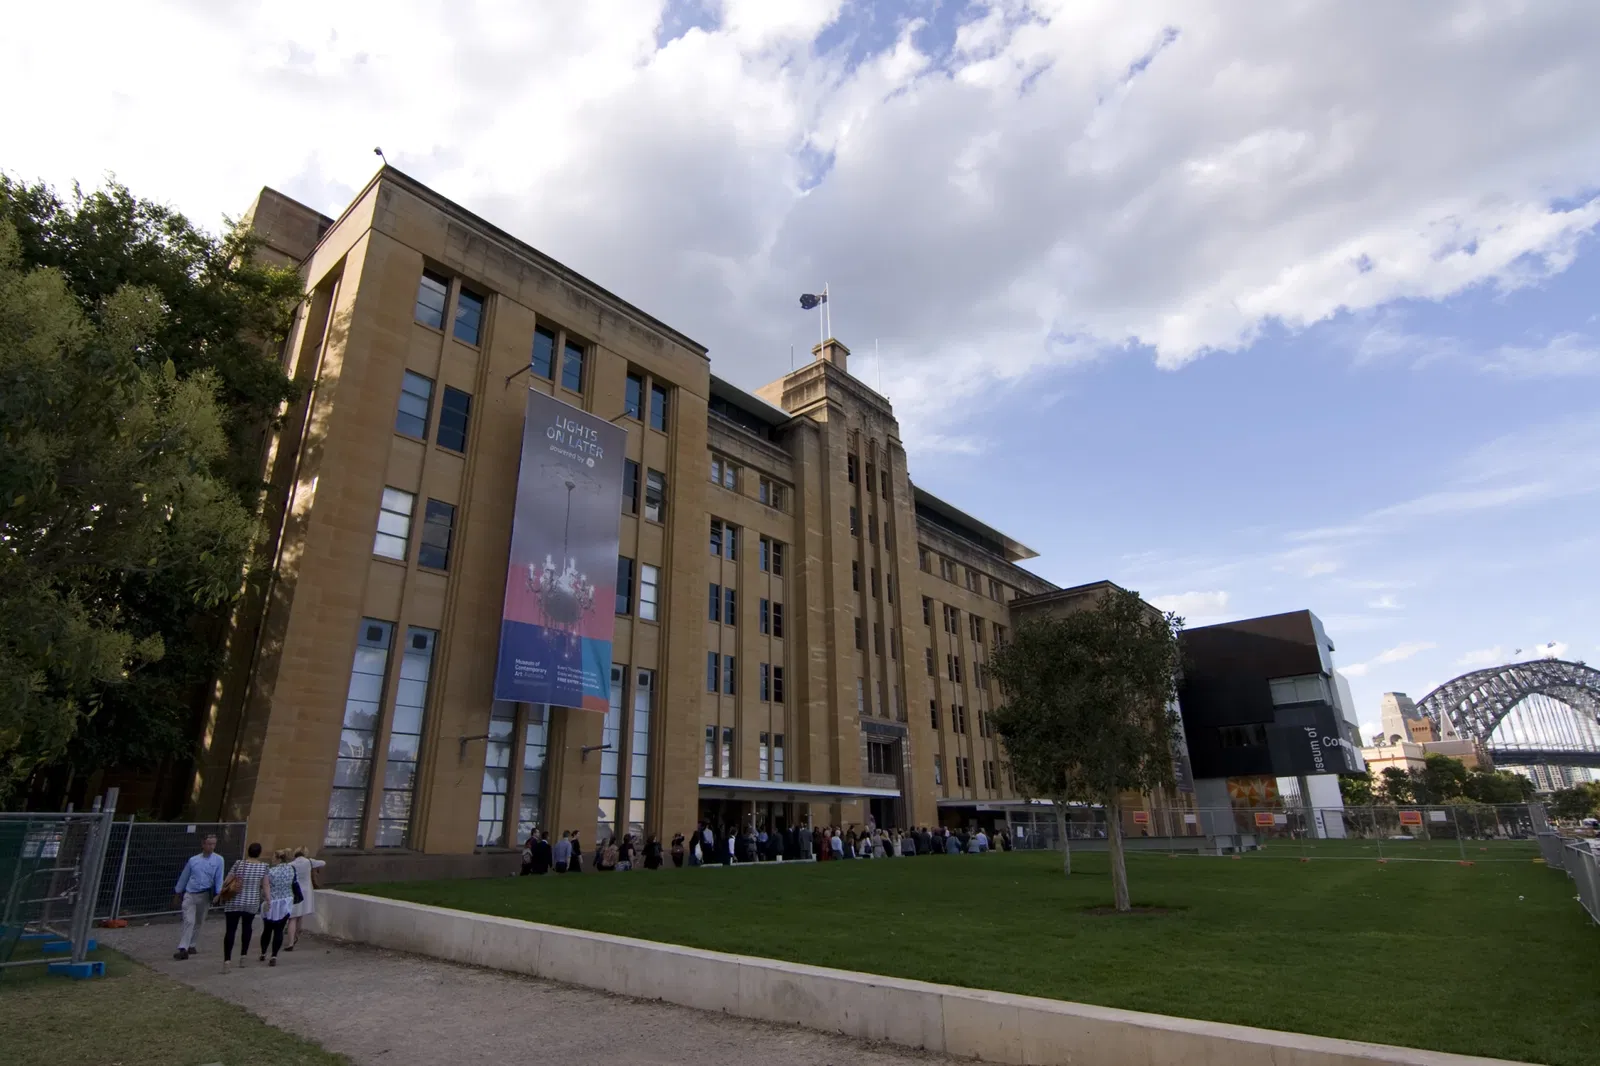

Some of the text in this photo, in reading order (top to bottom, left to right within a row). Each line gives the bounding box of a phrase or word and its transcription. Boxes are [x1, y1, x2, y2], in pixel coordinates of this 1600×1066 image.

[556, 415, 598, 442] LIGHTS
[546, 427, 604, 459] ON LATER
[514, 665, 547, 675] Contemporary
[1304, 727, 1317, 738] of
